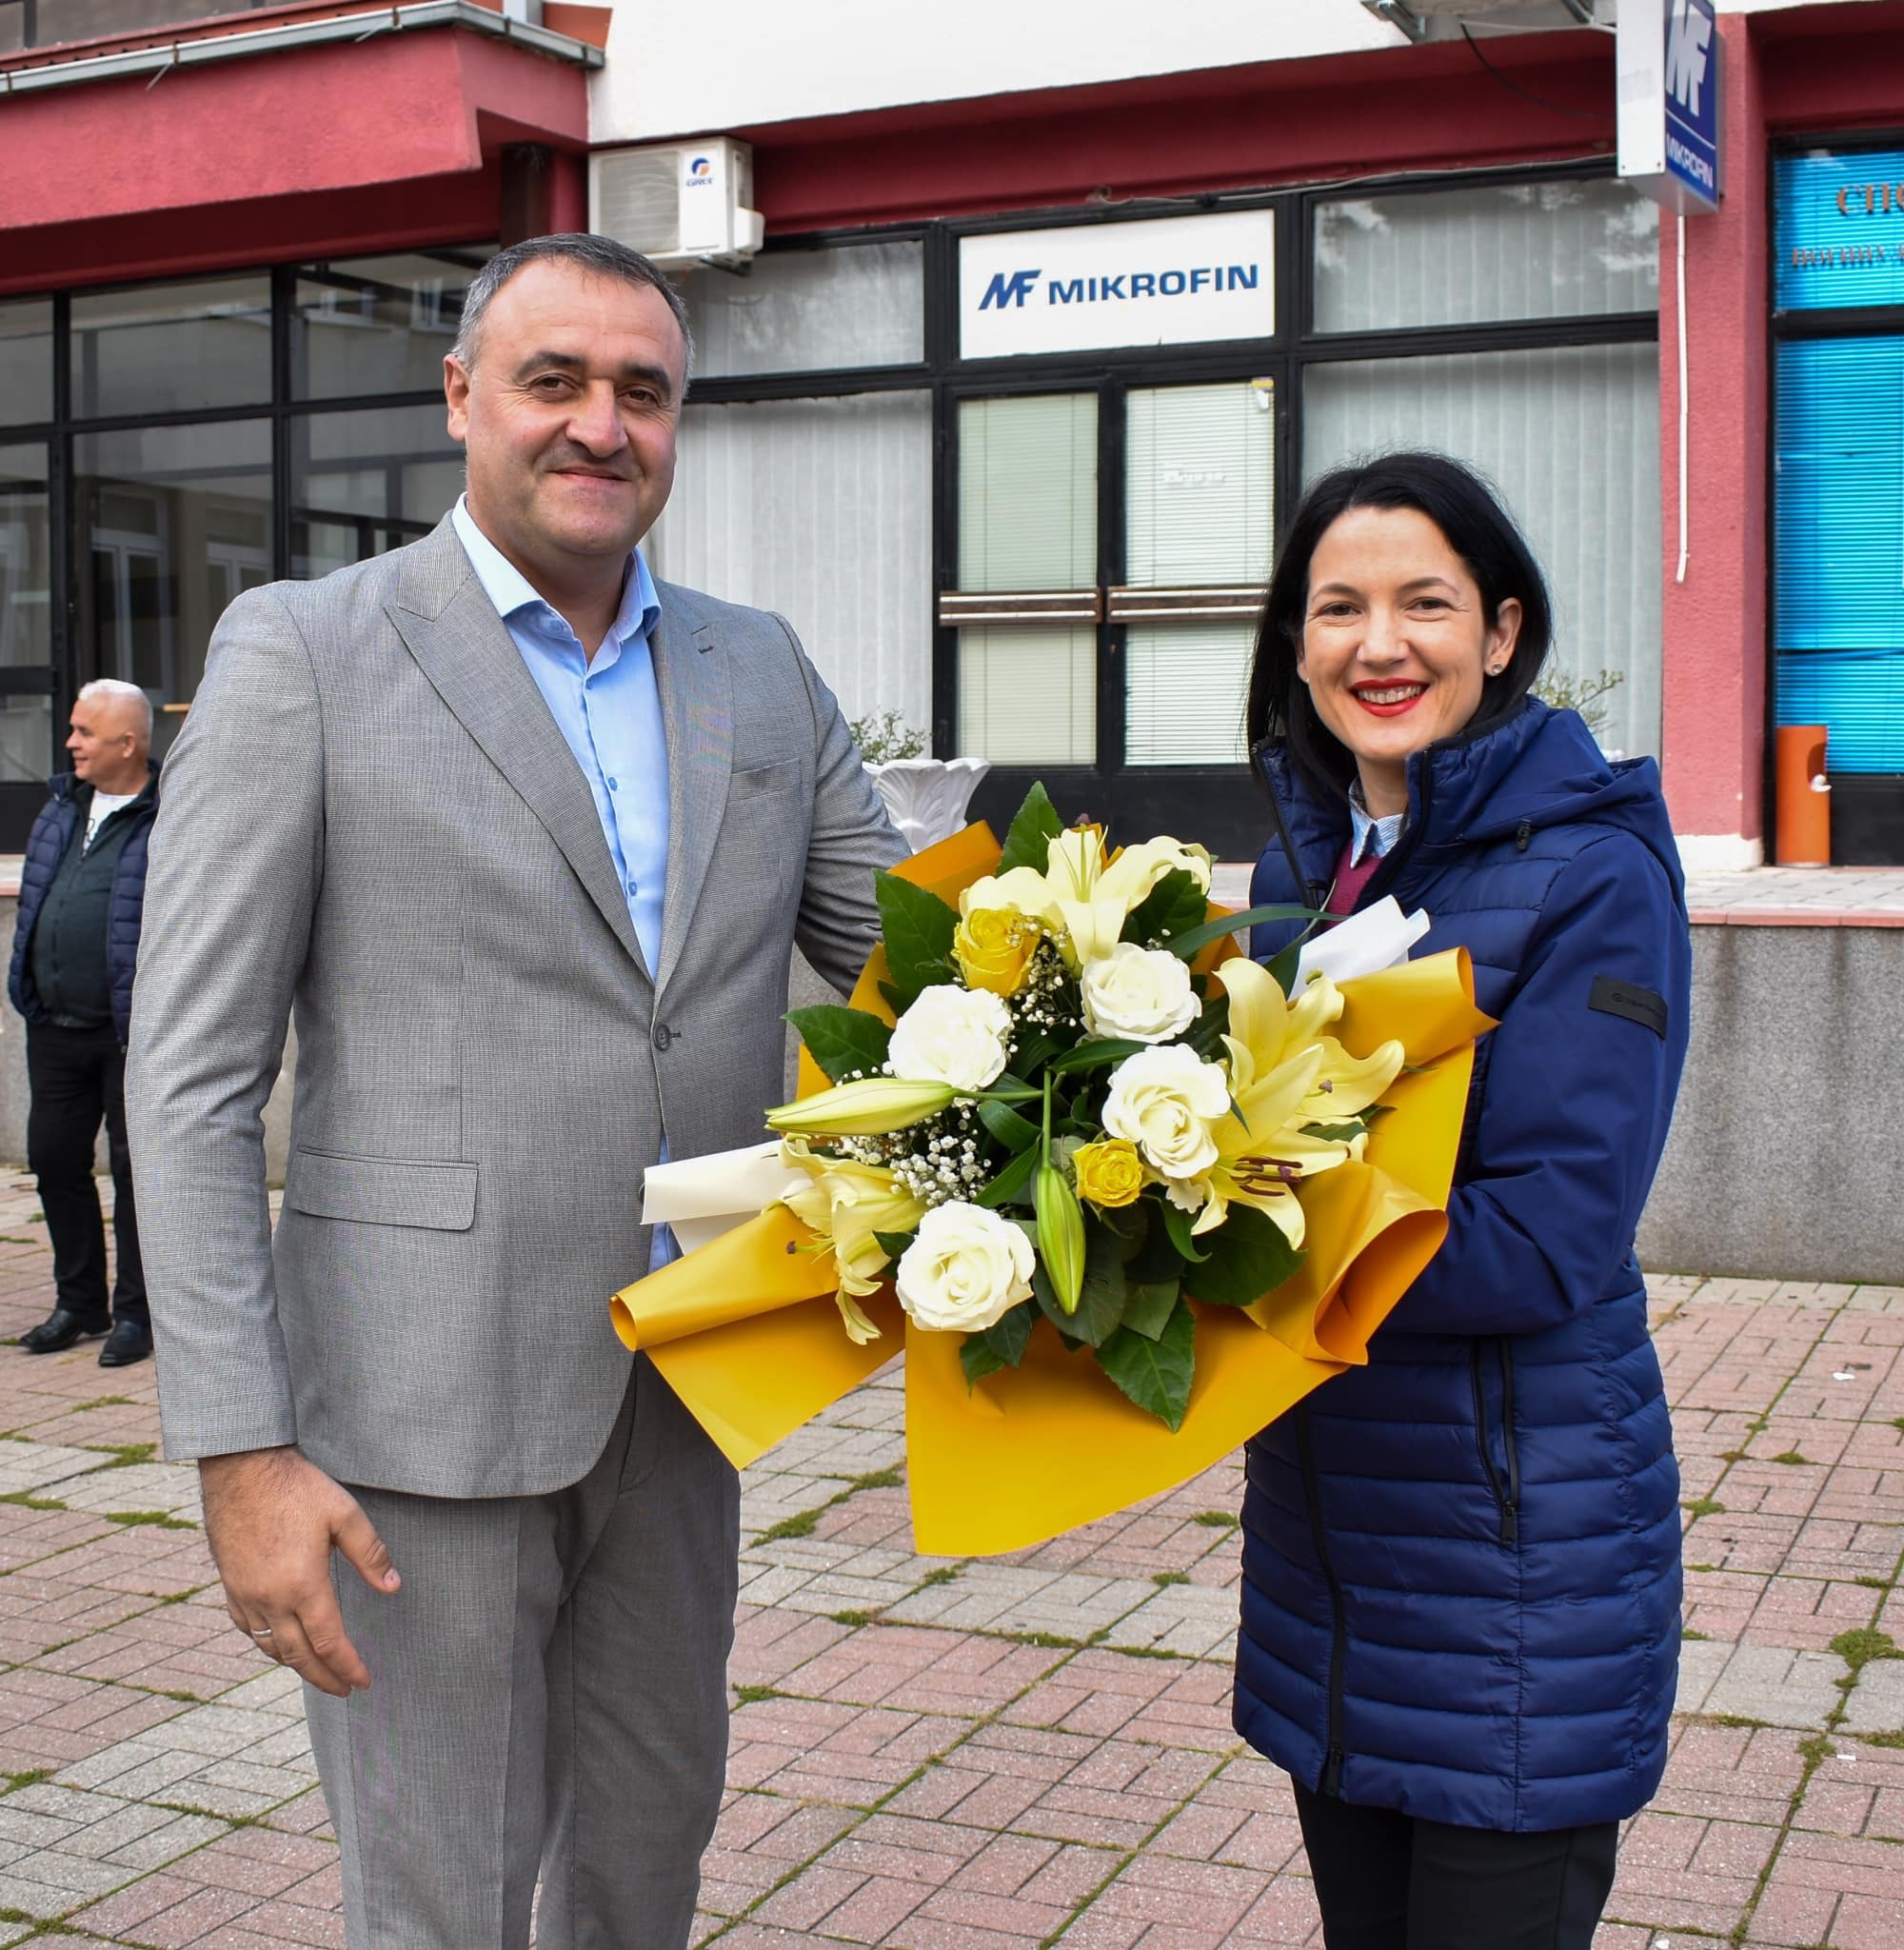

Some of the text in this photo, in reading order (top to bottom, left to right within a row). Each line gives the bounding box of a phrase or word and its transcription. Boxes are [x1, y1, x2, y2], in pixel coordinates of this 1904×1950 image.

[1665, 0, 1713, 117] MF
[978, 264, 1259, 310] MF MIKROFIN
